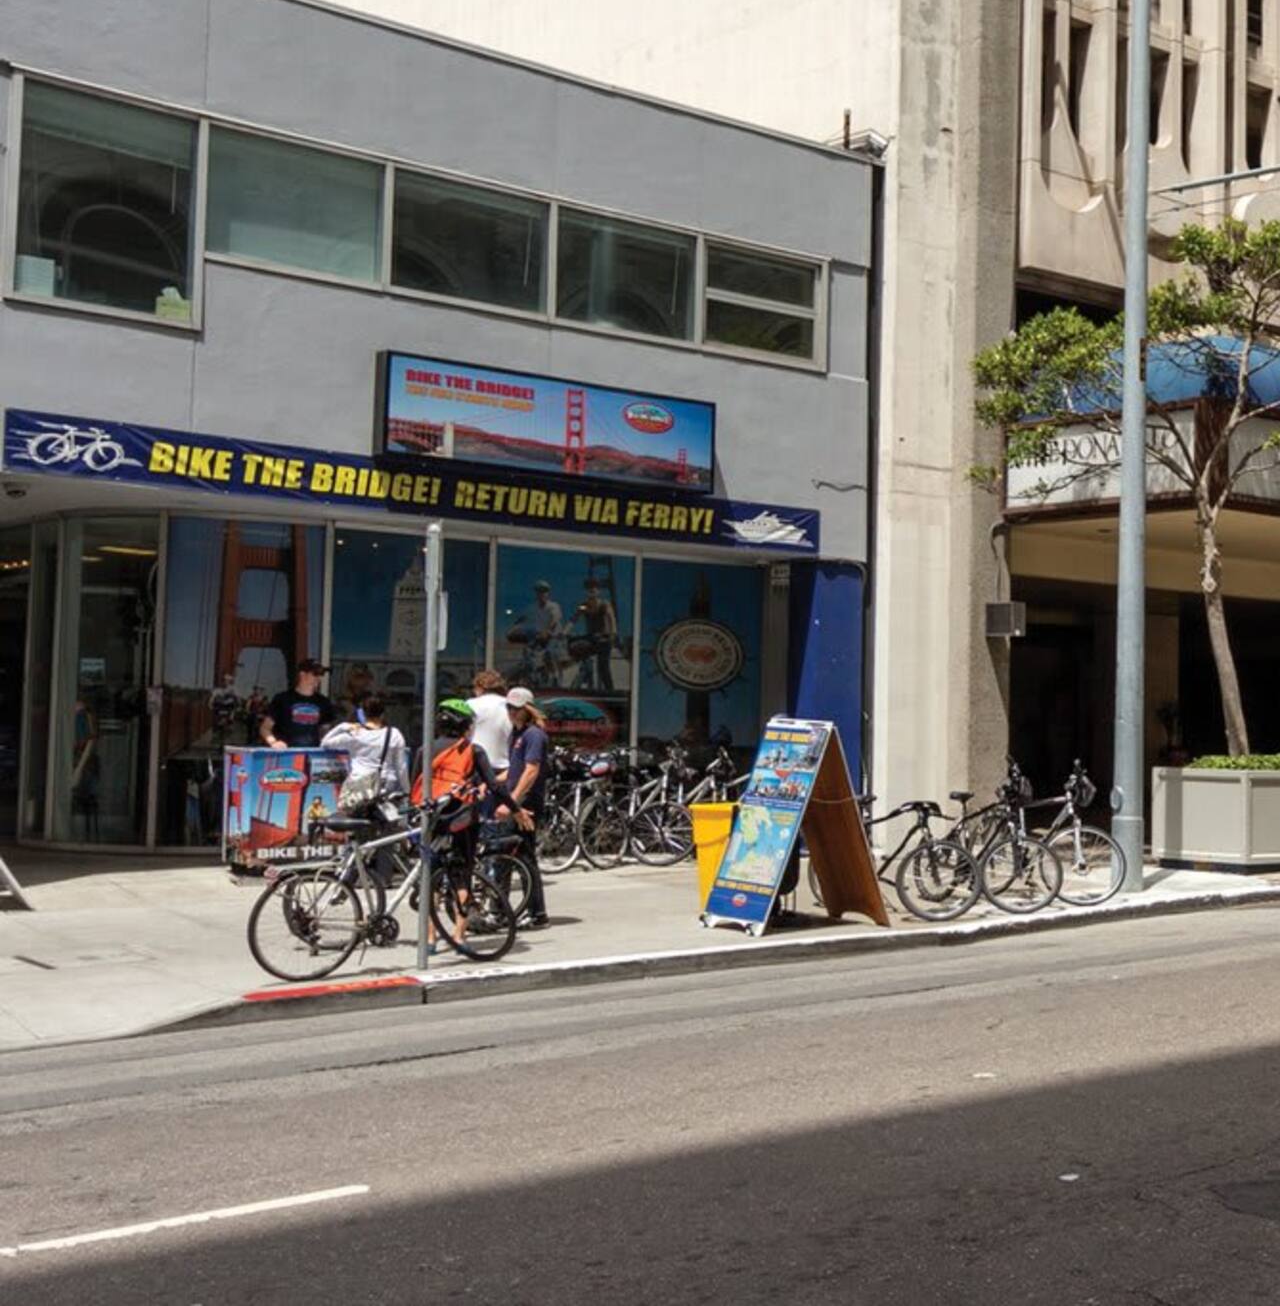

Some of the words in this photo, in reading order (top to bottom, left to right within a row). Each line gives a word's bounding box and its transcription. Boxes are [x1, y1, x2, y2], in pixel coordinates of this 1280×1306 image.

[406, 368, 441, 387] BIKE
[445, 373, 472, 391] THE
[476, 379, 535, 401] BRIDGE!
[149, 441, 235, 481] BIKE
[242, 453, 304, 489] THE
[309, 462, 443, 505] BRIDGE!
[454, 480, 567, 521] RETURN
[573, 494, 619, 525] VIA
[625, 501, 715, 535] FERRY!
[257, 846, 297, 860] BIKE
[301, 844, 334, 859] THE
